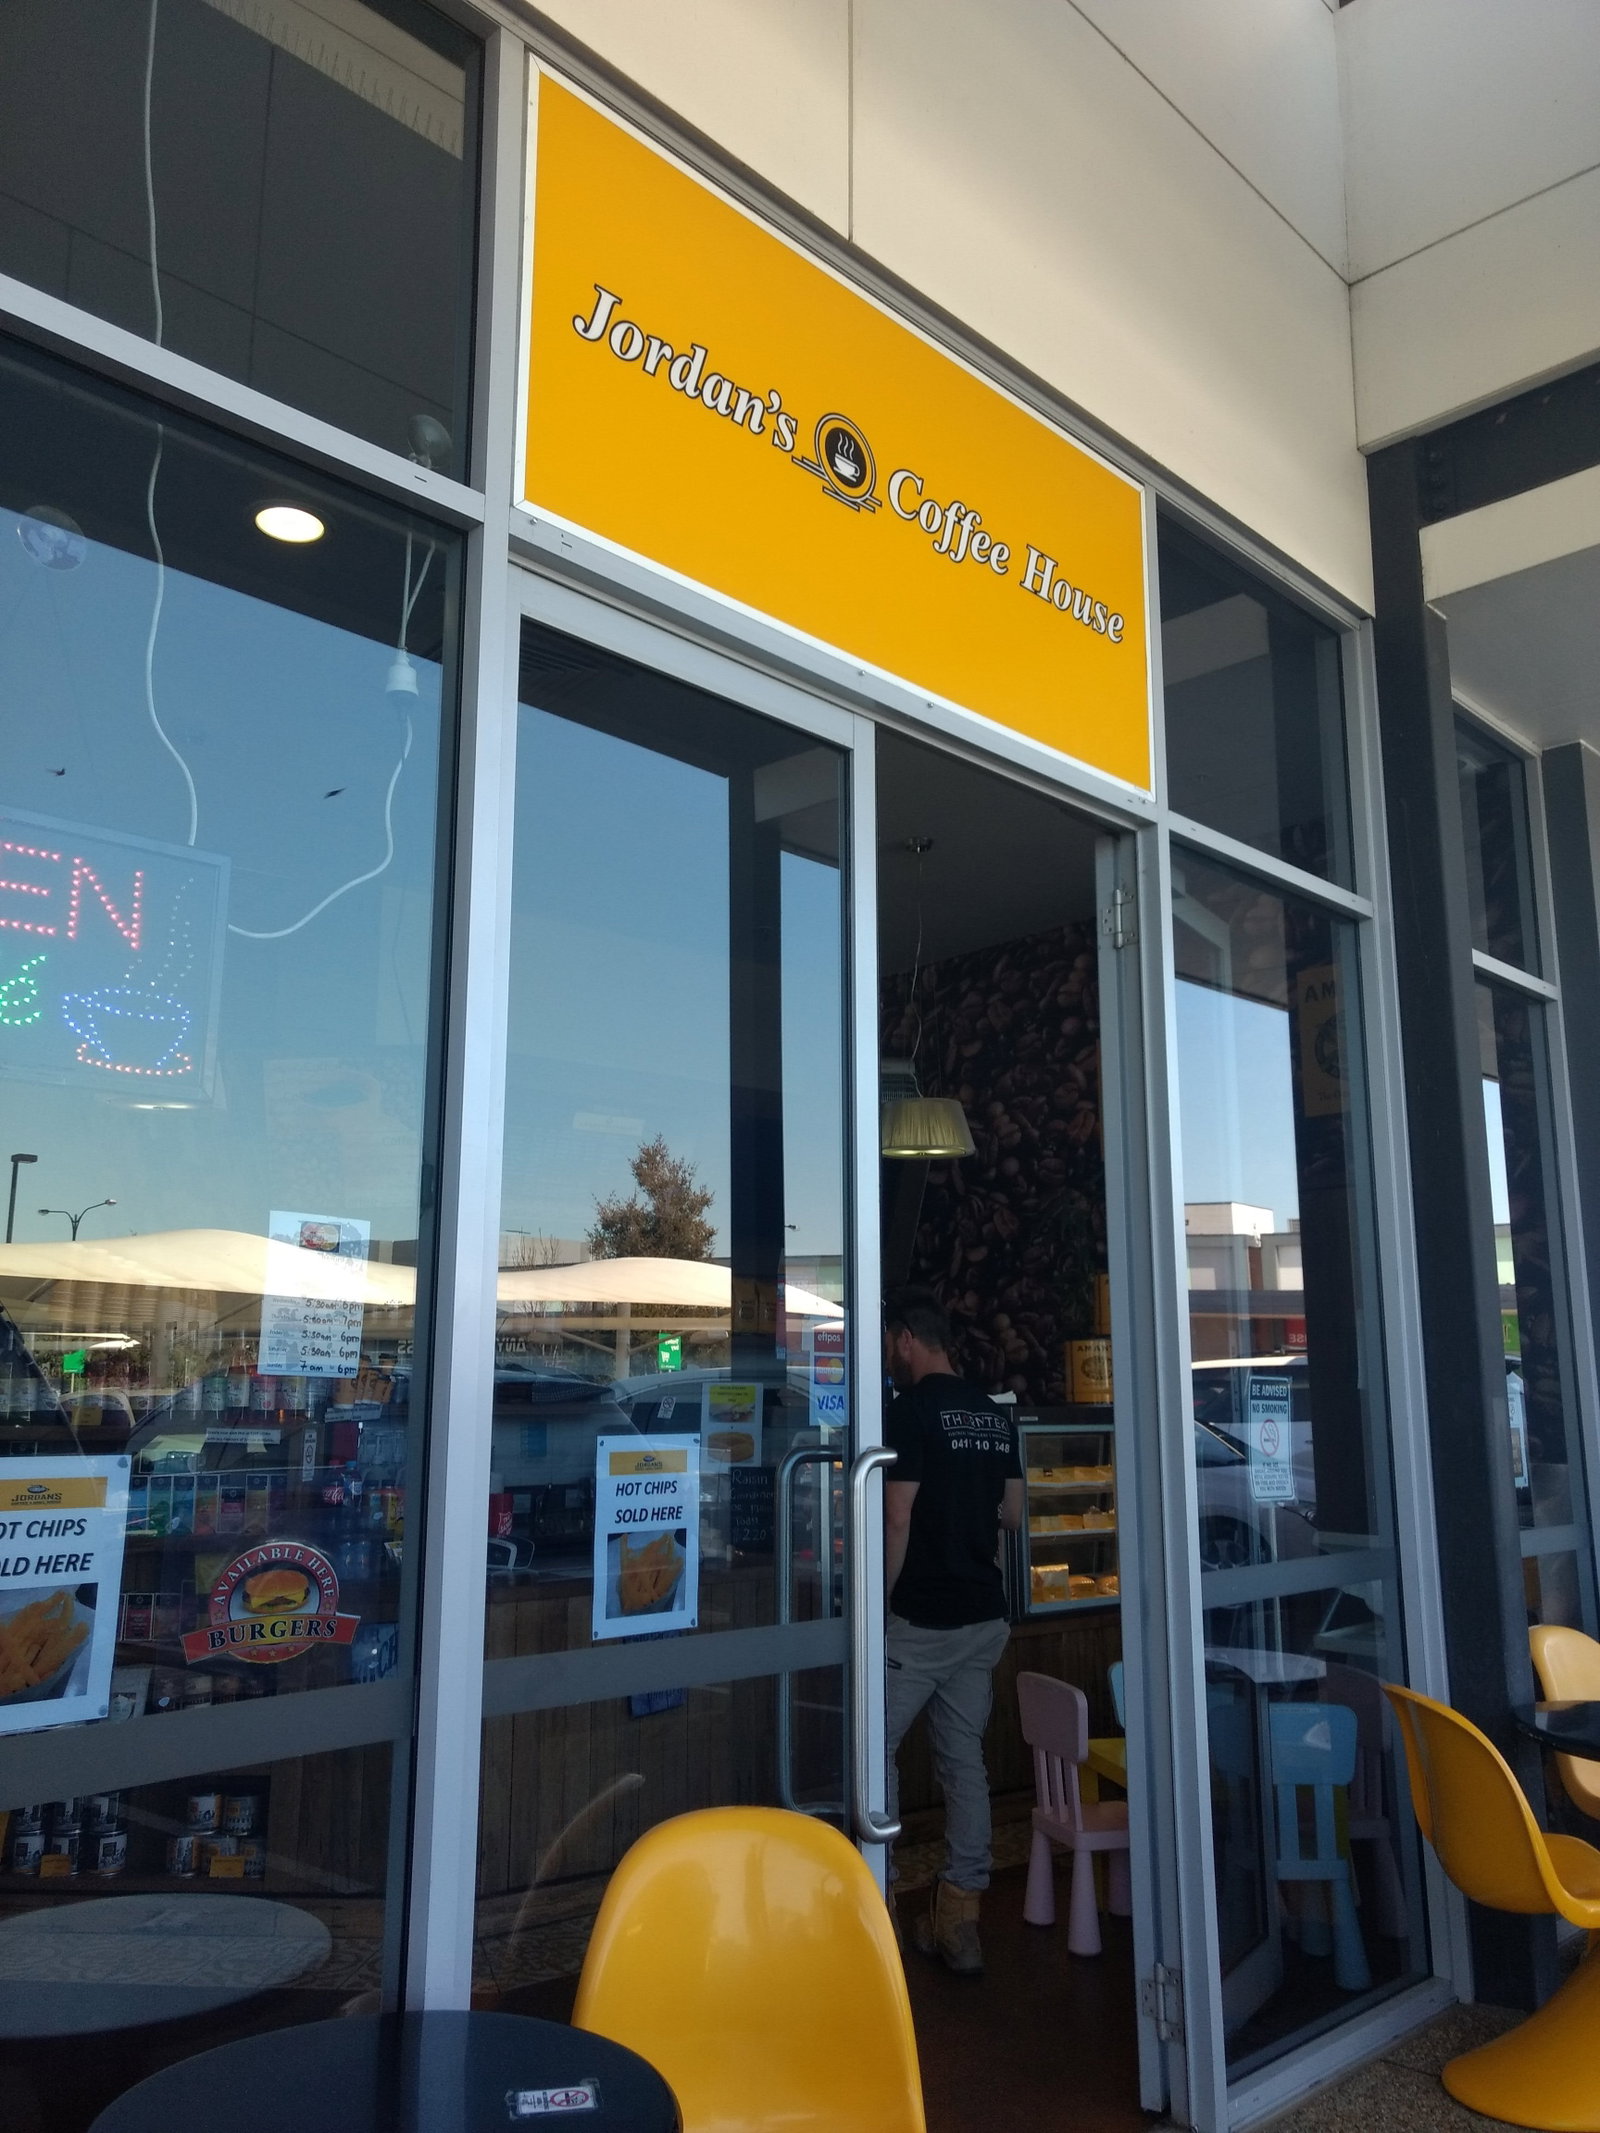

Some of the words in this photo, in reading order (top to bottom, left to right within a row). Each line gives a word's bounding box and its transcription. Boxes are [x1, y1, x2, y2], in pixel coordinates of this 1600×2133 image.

[572, 284, 798, 453] Jordan's
[888, 469, 1011, 576] Coffee
[1020, 544, 1125, 643] House
[340, 1331, 360, 1345] 6pm
[817, 1330, 841, 1344] eftpos
[300, 1345, 331, 1358] 5:30am
[338, 1346, 358, 1360] 6pm
[337, 1364, 357, 1375] 6pm
[1251, 1384, 1261, 1396] BE
[1261, 1384, 1288, 1397] ADVISED
[817, 1395, 845, 1410] VISA
[1251, 1402, 1260, 1414] NO
[1261, 1402, 1288, 1415] SMOKING
[616, 1482, 642, 1497] HOT
[644, 1480, 678, 1495] CHIPS
[614, 1507, 649, 1524] SOLD
[651, 1505, 683, 1521] HERE
[26, 1518, 87, 1539] CHIPS
[34, 1552, 94, 1575] HERE
[213, 1547, 304, 1606] AVAILABLE
[306, 1556, 336, 1599] HERE
[208, 1618, 338, 1650] BURGERS
